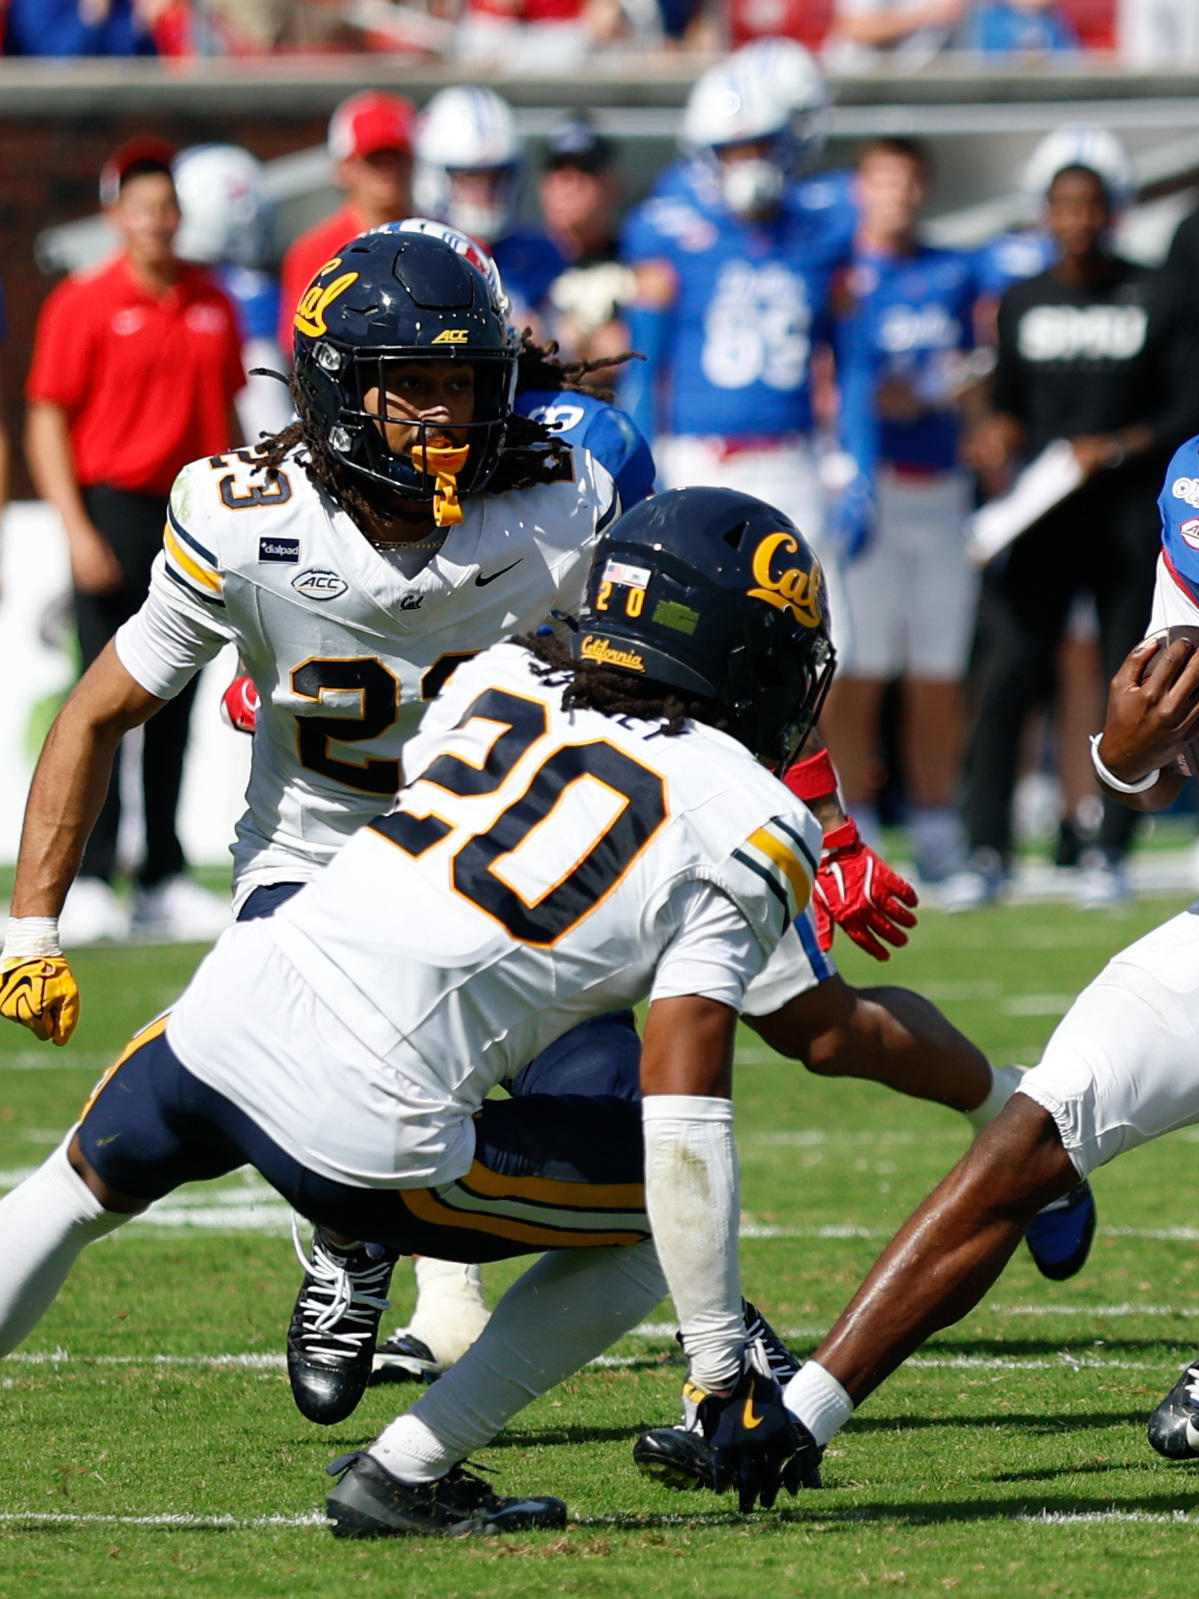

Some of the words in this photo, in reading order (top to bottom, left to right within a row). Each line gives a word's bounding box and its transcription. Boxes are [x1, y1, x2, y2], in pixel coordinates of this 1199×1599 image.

[431, 330, 469, 344] ACC
[264, 542, 299, 557] dialpad
[302, 576, 340, 590] ACC
[746, 532, 822, 629] Cal
[400, 596, 424, 611] Cal
[597, 581, 646, 618] 20
[579, 635, 647, 673] California
[363, 686, 671, 949] 20
